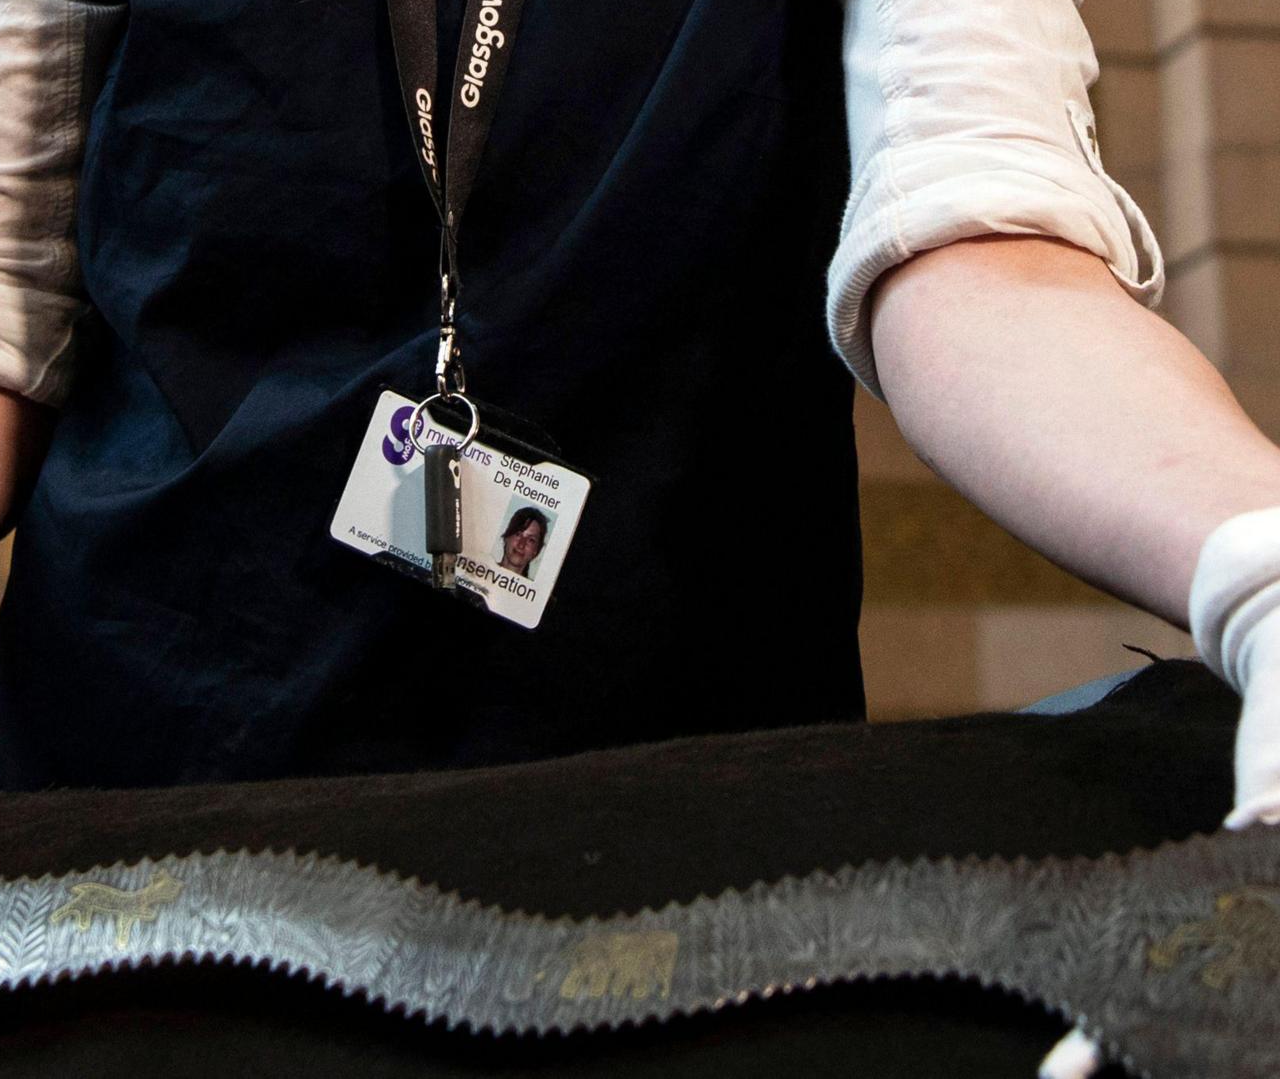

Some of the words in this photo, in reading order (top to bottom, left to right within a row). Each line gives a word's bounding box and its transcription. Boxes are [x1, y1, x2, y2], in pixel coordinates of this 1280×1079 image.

[493, 470, 511, 487] De
[513, 479, 561, 510] Roemer
[500, 454, 560, 490] Stephanie
[348, 525, 356, 535] A
[357, 529, 387, 549] service
[388, 544, 424, 566] provided
[456, 555, 537, 602] nservation
